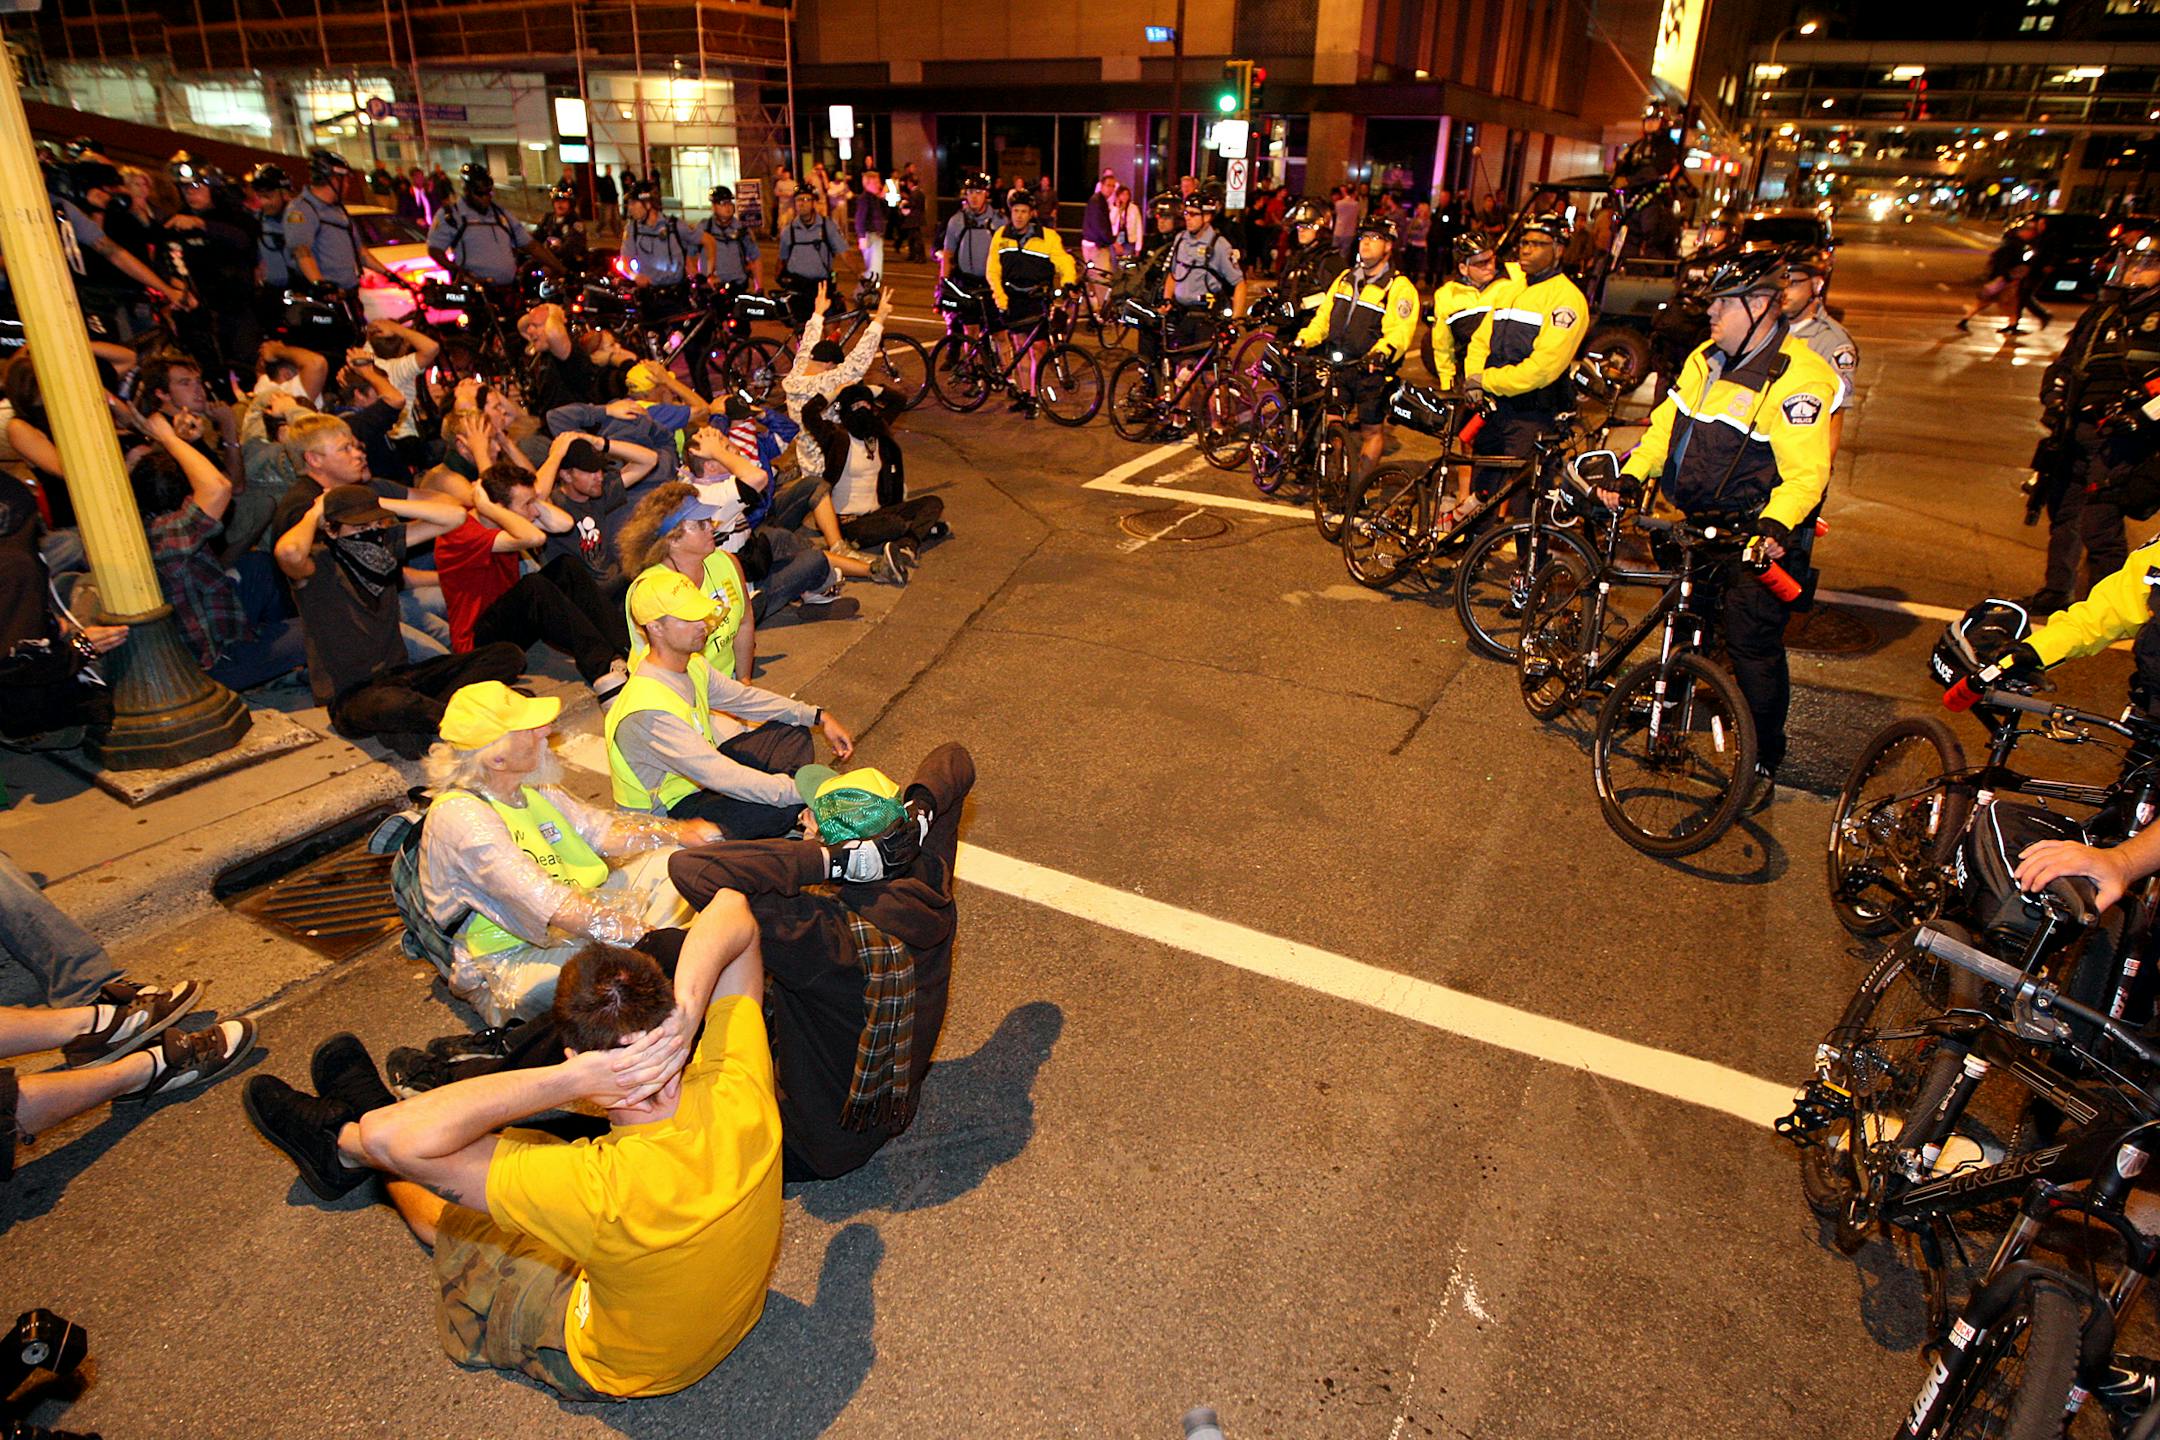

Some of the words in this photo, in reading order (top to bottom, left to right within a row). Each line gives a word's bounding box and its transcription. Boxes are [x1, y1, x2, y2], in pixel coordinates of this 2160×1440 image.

[313, 316, 331, 324] POLICE
[1394, 405, 1411, 419] POLICE
[1933, 652, 1954, 684] POLICE
[1861, 948, 1896, 994] BONTRAGER
[1948, 1151, 2042, 1195] TREK
[1953, 1316, 1976, 1342] OCK
